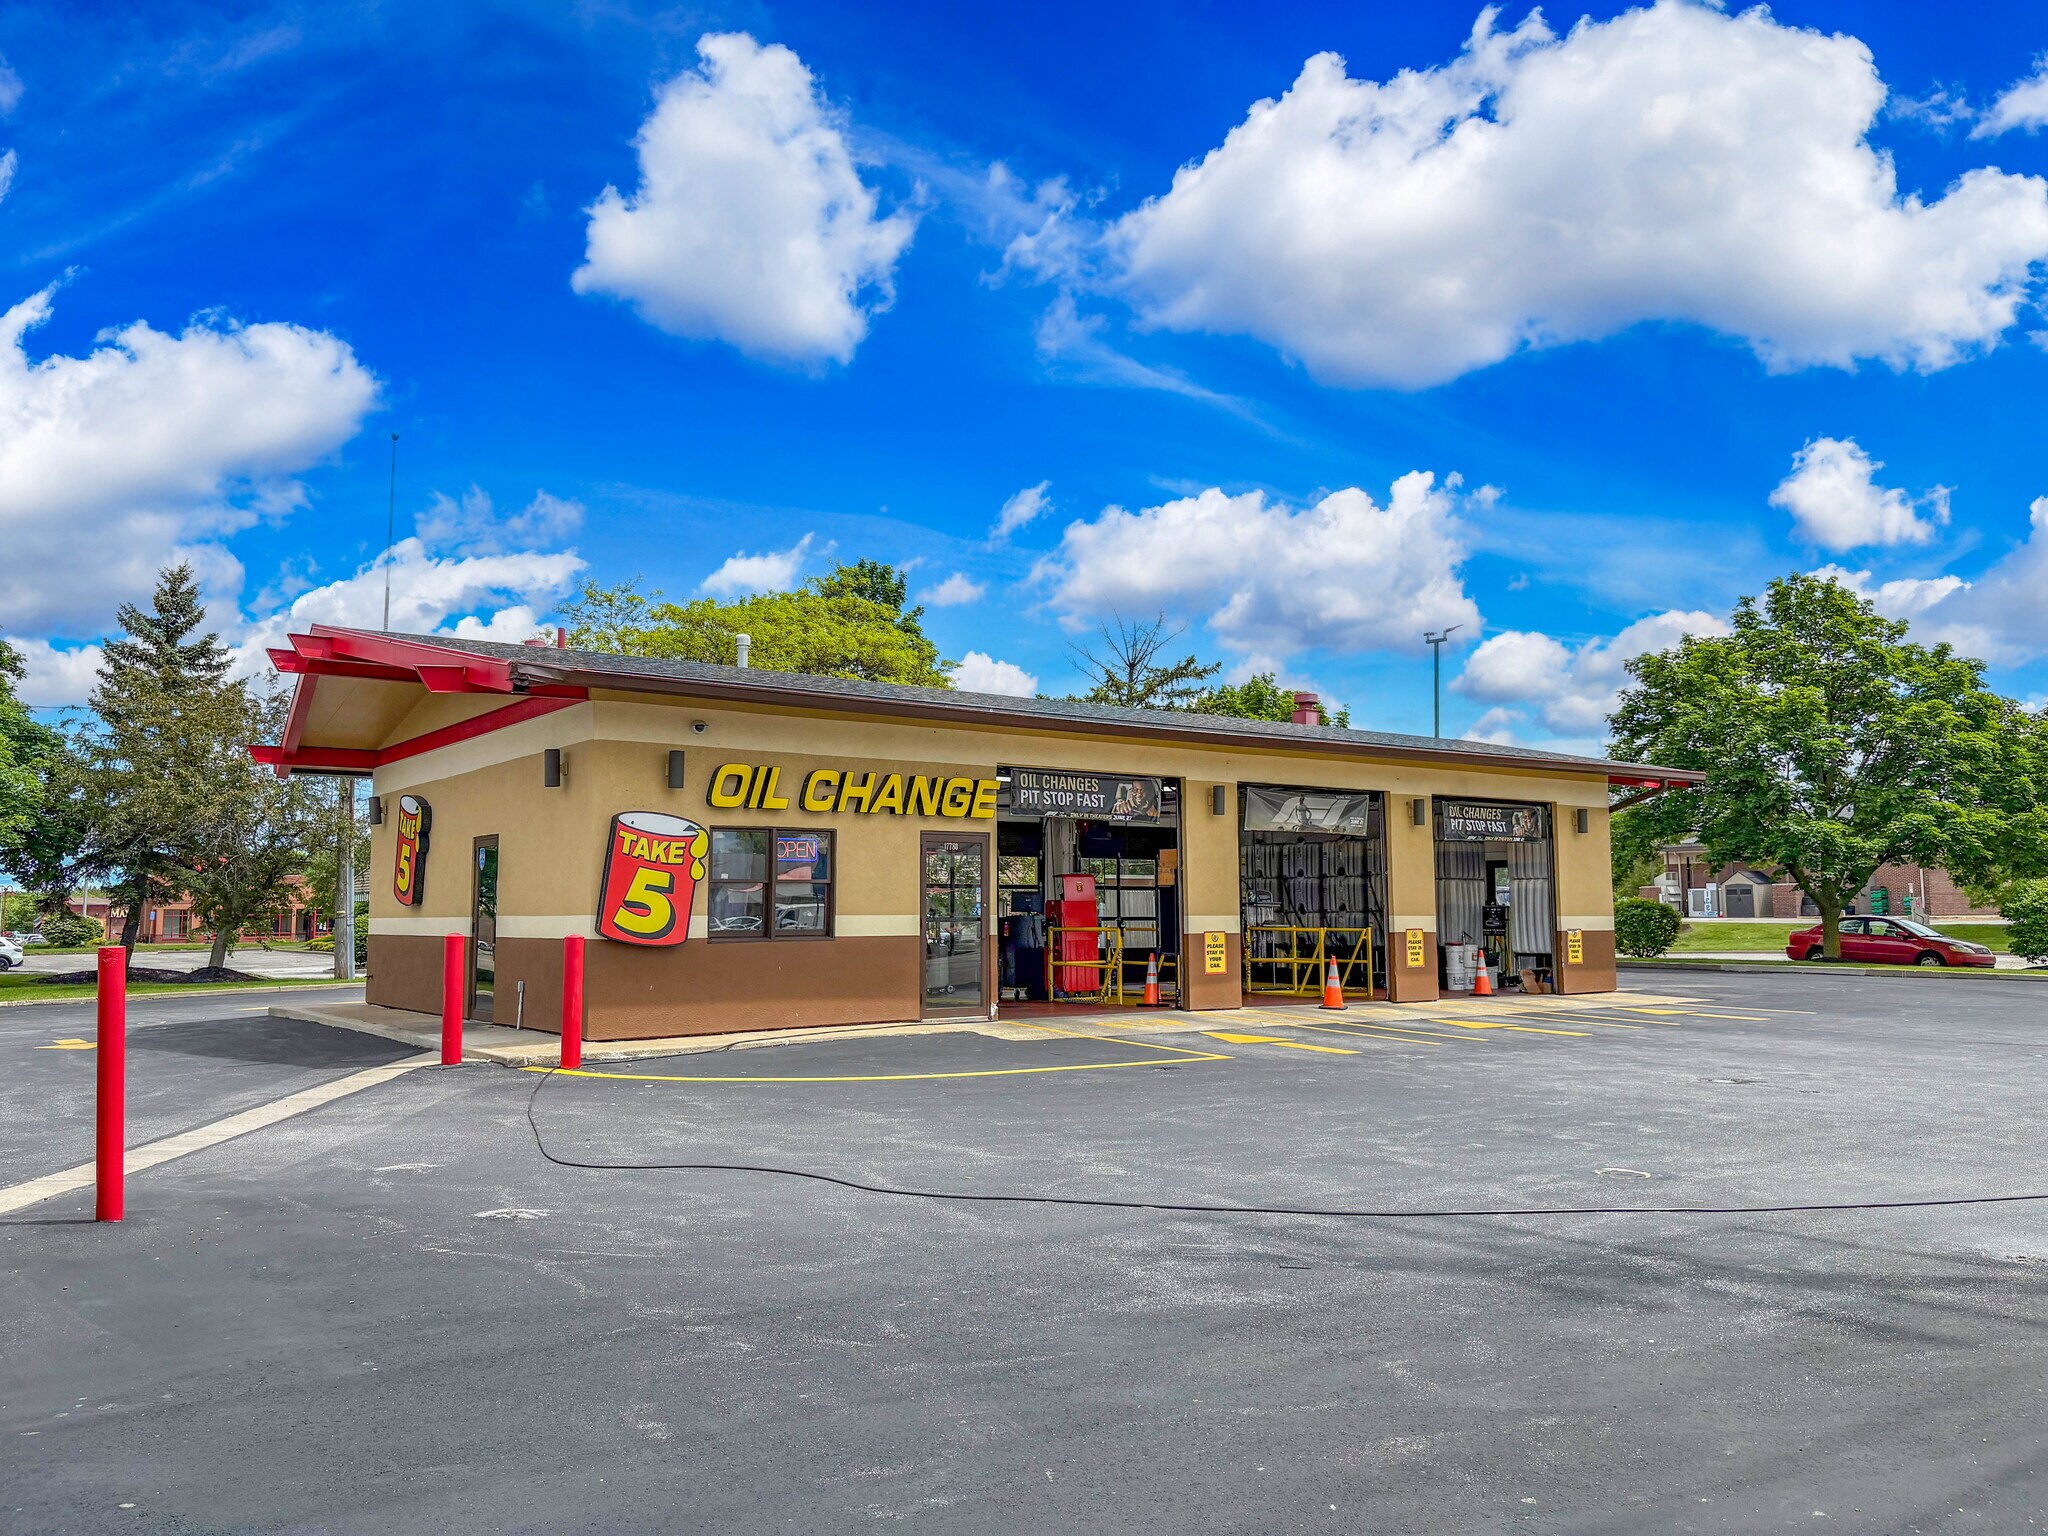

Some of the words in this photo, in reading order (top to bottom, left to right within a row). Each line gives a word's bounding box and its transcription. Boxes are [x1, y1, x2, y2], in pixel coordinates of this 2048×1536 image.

[707, 763, 790, 810] OIL
[800, 769, 1001, 819] CHANGE
[1020, 773, 1039, 788] OIL
[1042, 775, 1099, 792] CHANGES
[1020, 789, 1040, 804] PIT
[1043, 790, 1074, 807] STOP
[1077, 793, 1106, 808] FAST
[400, 810, 416, 840] TAKE
[1463, 807, 1502, 820] CHANGES
[1450, 819, 1464, 830] PIT
[1466, 819, 1486, 832] STOP
[1487, 820, 1507, 833] FAST
[618, 830, 686, 865] TAKE
[777, 841, 817, 859] OPEN
[397, 843, 411, 894] 5
[612, 866, 676, 938] 5
